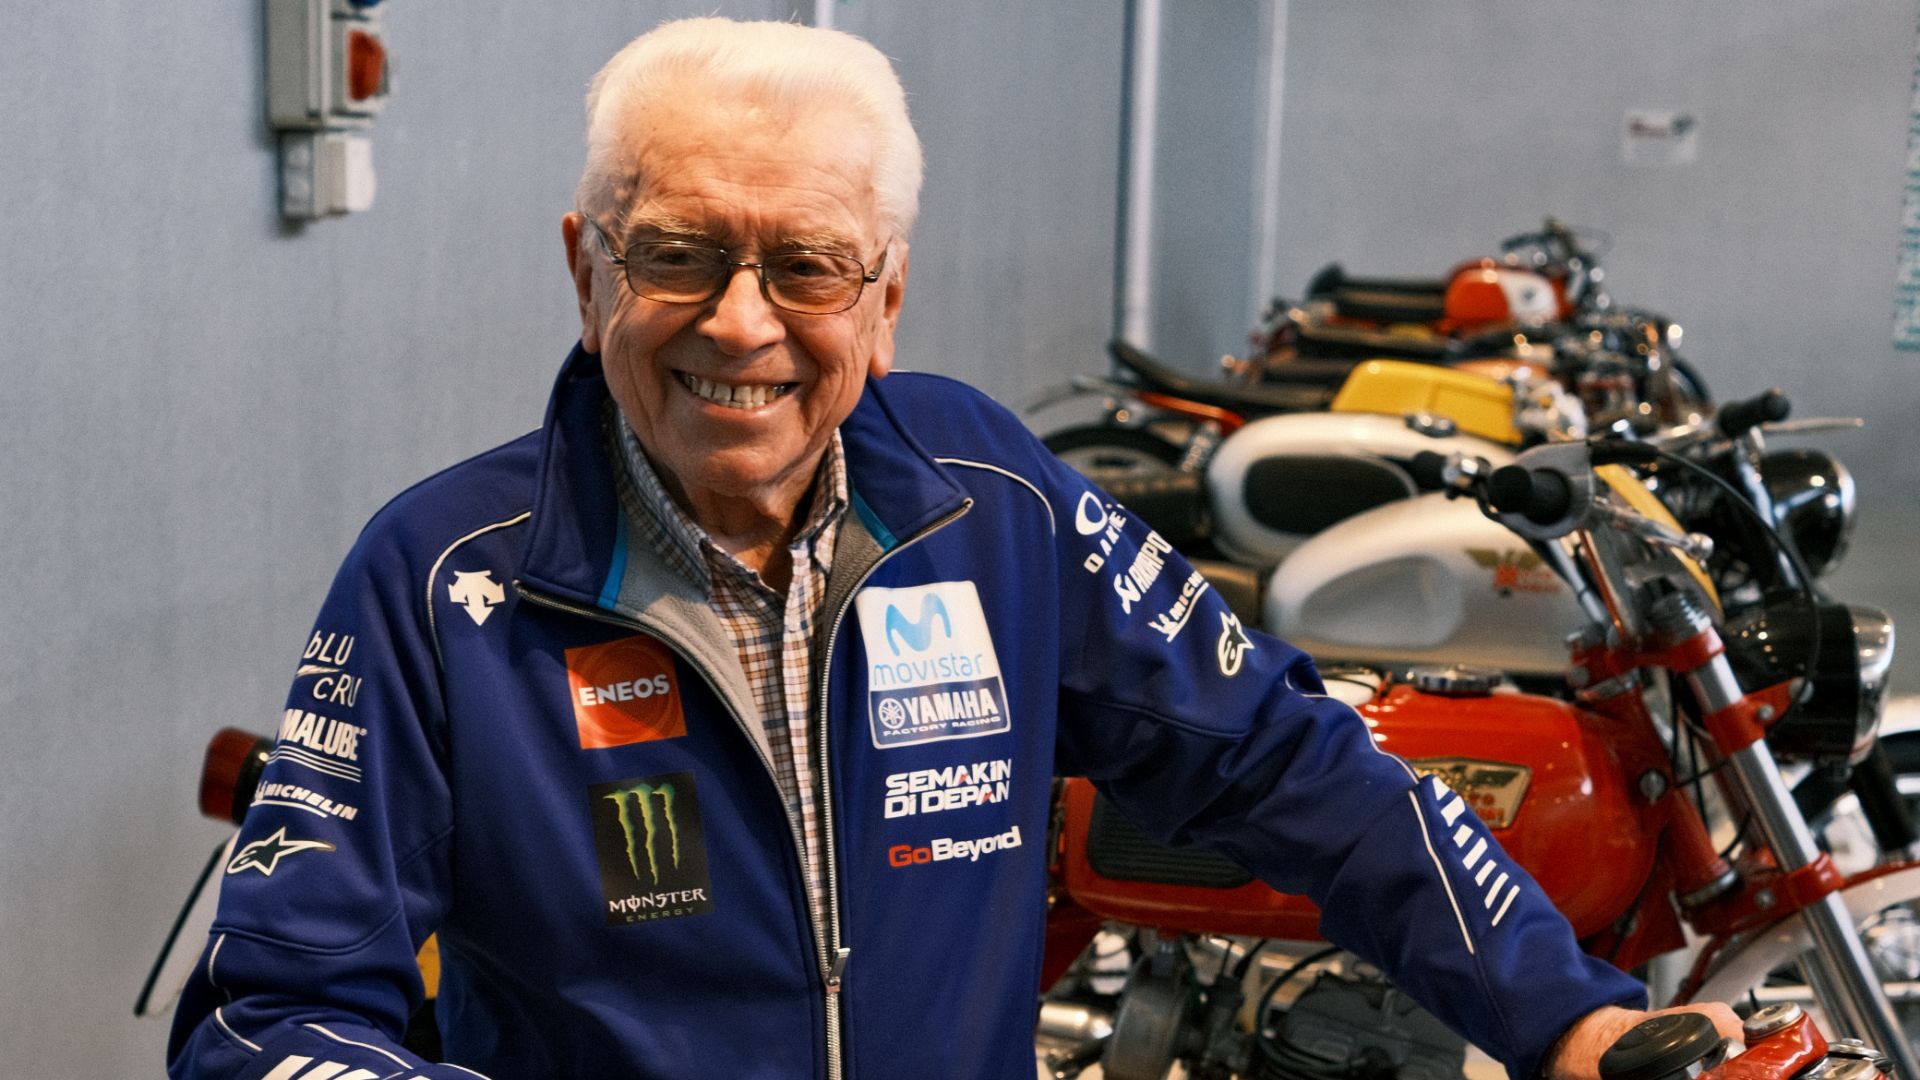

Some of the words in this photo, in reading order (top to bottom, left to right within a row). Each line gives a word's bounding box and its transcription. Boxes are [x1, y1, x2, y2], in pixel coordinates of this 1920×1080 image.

[873, 653, 983, 686] movistar
[578, 674, 670, 707] ENEOS
[903, 688, 999, 726] YAMAHA
[882, 722, 948, 737] FACTORY
[951, 716, 1001, 728] RACING
[885, 759, 1012, 797] SEMAKIN
[921, 780, 1010, 814] DEPAN
[608, 888, 707, 914] MONSTER
[626, 907, 694, 922] ENERGY
